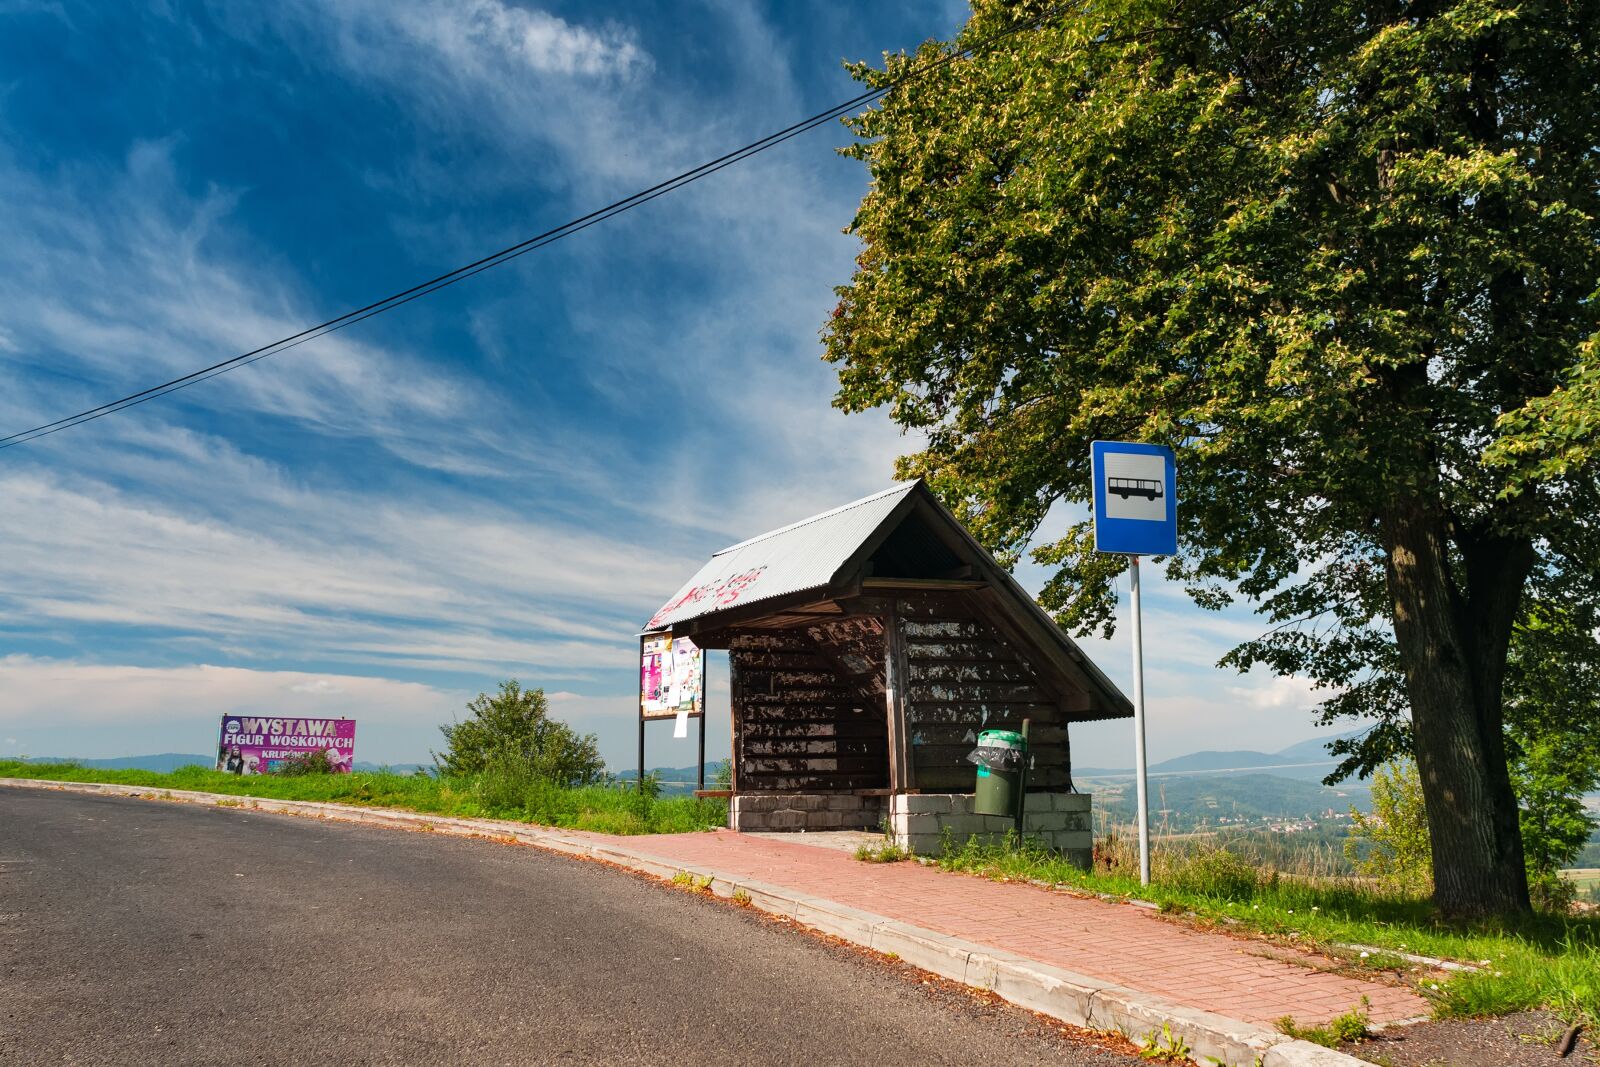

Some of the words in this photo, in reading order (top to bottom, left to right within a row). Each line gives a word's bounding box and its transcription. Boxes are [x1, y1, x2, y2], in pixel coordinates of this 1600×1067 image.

[241, 718, 337, 736] WYSTAWA
[224, 734, 264, 745] FIGUR
[270, 735, 353, 748] WOSKOWYCH
